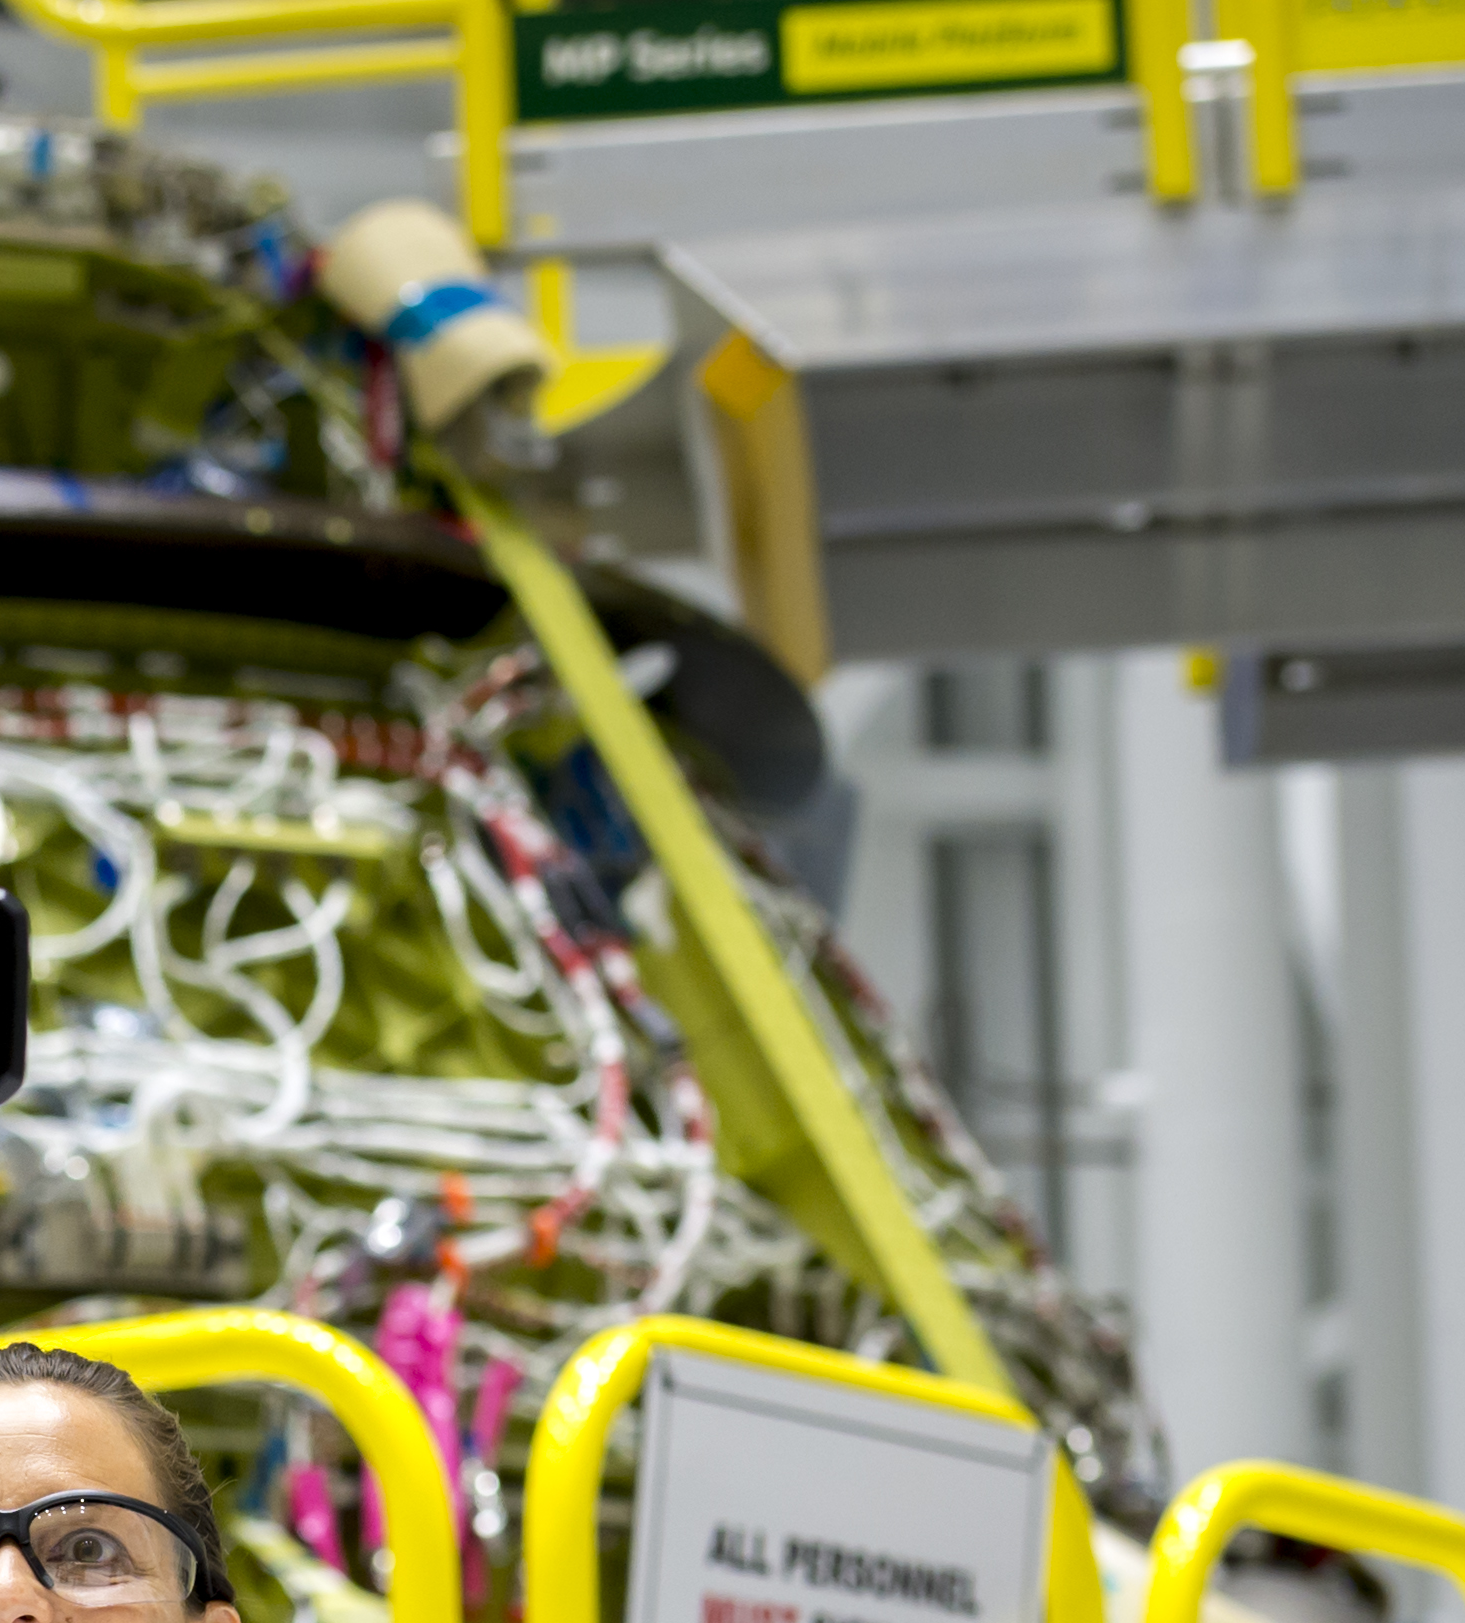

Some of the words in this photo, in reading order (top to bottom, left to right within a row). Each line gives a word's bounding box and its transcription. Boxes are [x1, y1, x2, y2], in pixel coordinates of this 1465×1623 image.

[542, 35, 618, 84] MP
[627, 25, 771, 84] Series
[711, 1526, 770, 1576] ALL
[785, 1538, 979, 1614] PERSONNEL
